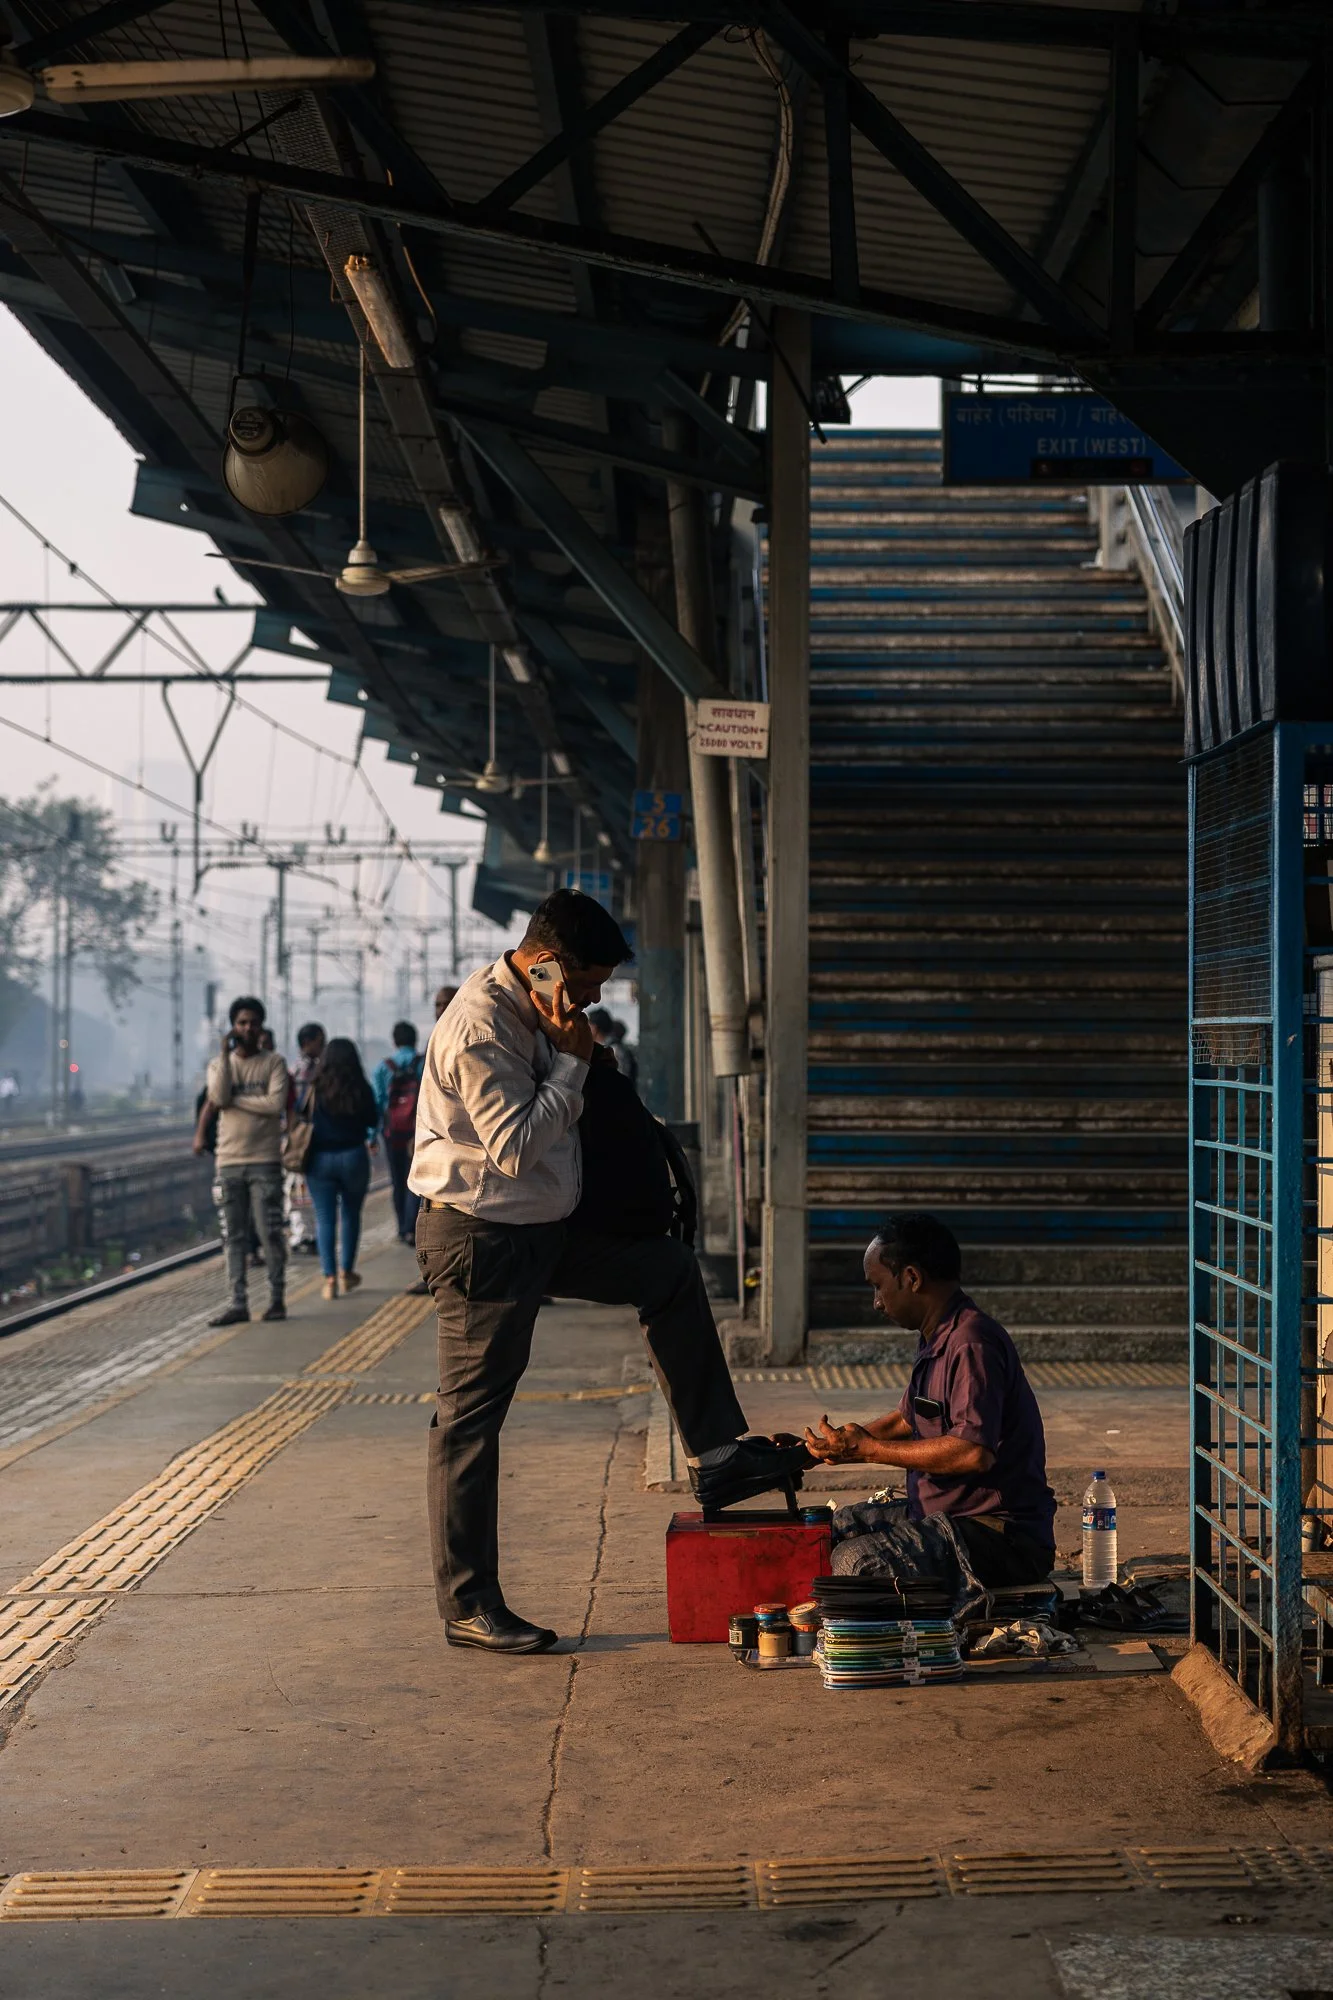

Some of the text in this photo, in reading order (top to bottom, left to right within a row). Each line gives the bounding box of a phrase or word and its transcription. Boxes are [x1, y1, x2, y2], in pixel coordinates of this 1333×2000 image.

[1036, 436, 1146, 456] EXIT (WEST)
[711, 707, 756, 720] सावधान
[707, 723, 758, 734] CAUTION
[699, 738, 763, 750] 25000 VOLTS
[640, 816, 671, 838] 26
